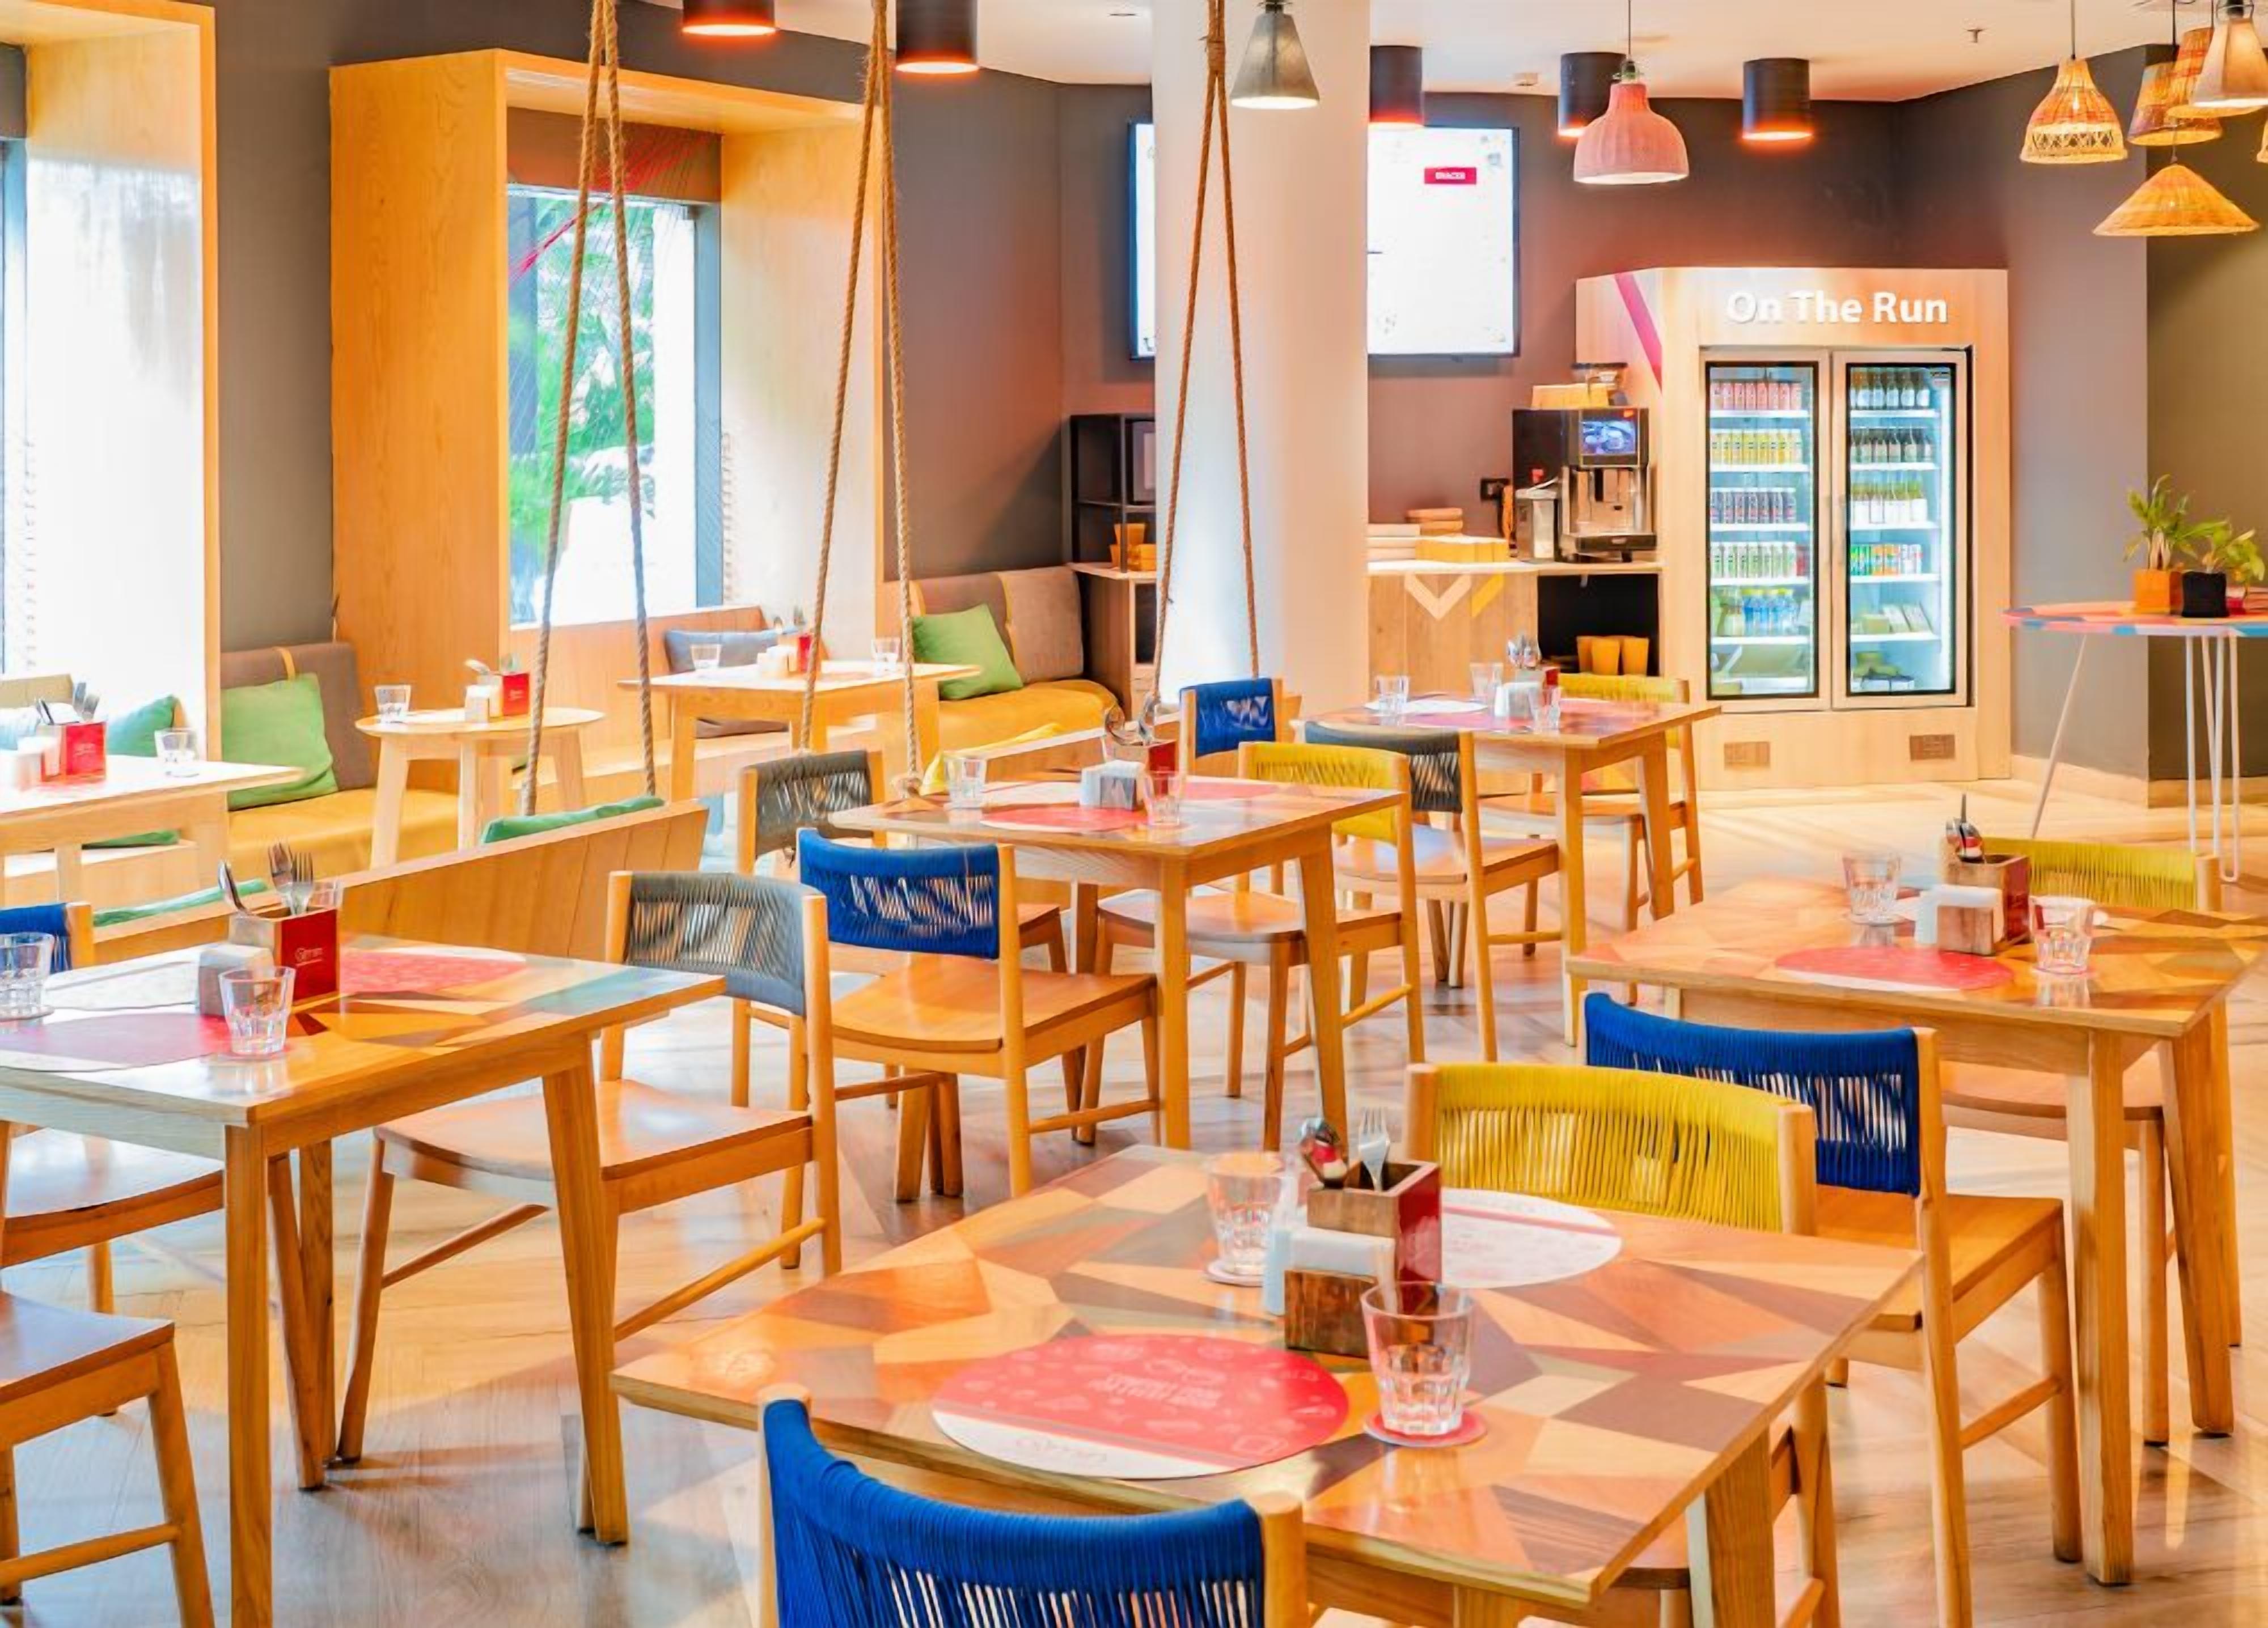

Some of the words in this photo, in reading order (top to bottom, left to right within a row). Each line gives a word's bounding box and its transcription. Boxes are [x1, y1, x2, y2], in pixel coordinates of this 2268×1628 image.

[1727, 291, 1783, 324] On
[1788, 290, 1863, 324] The
[1873, 291, 1948, 324] Run
